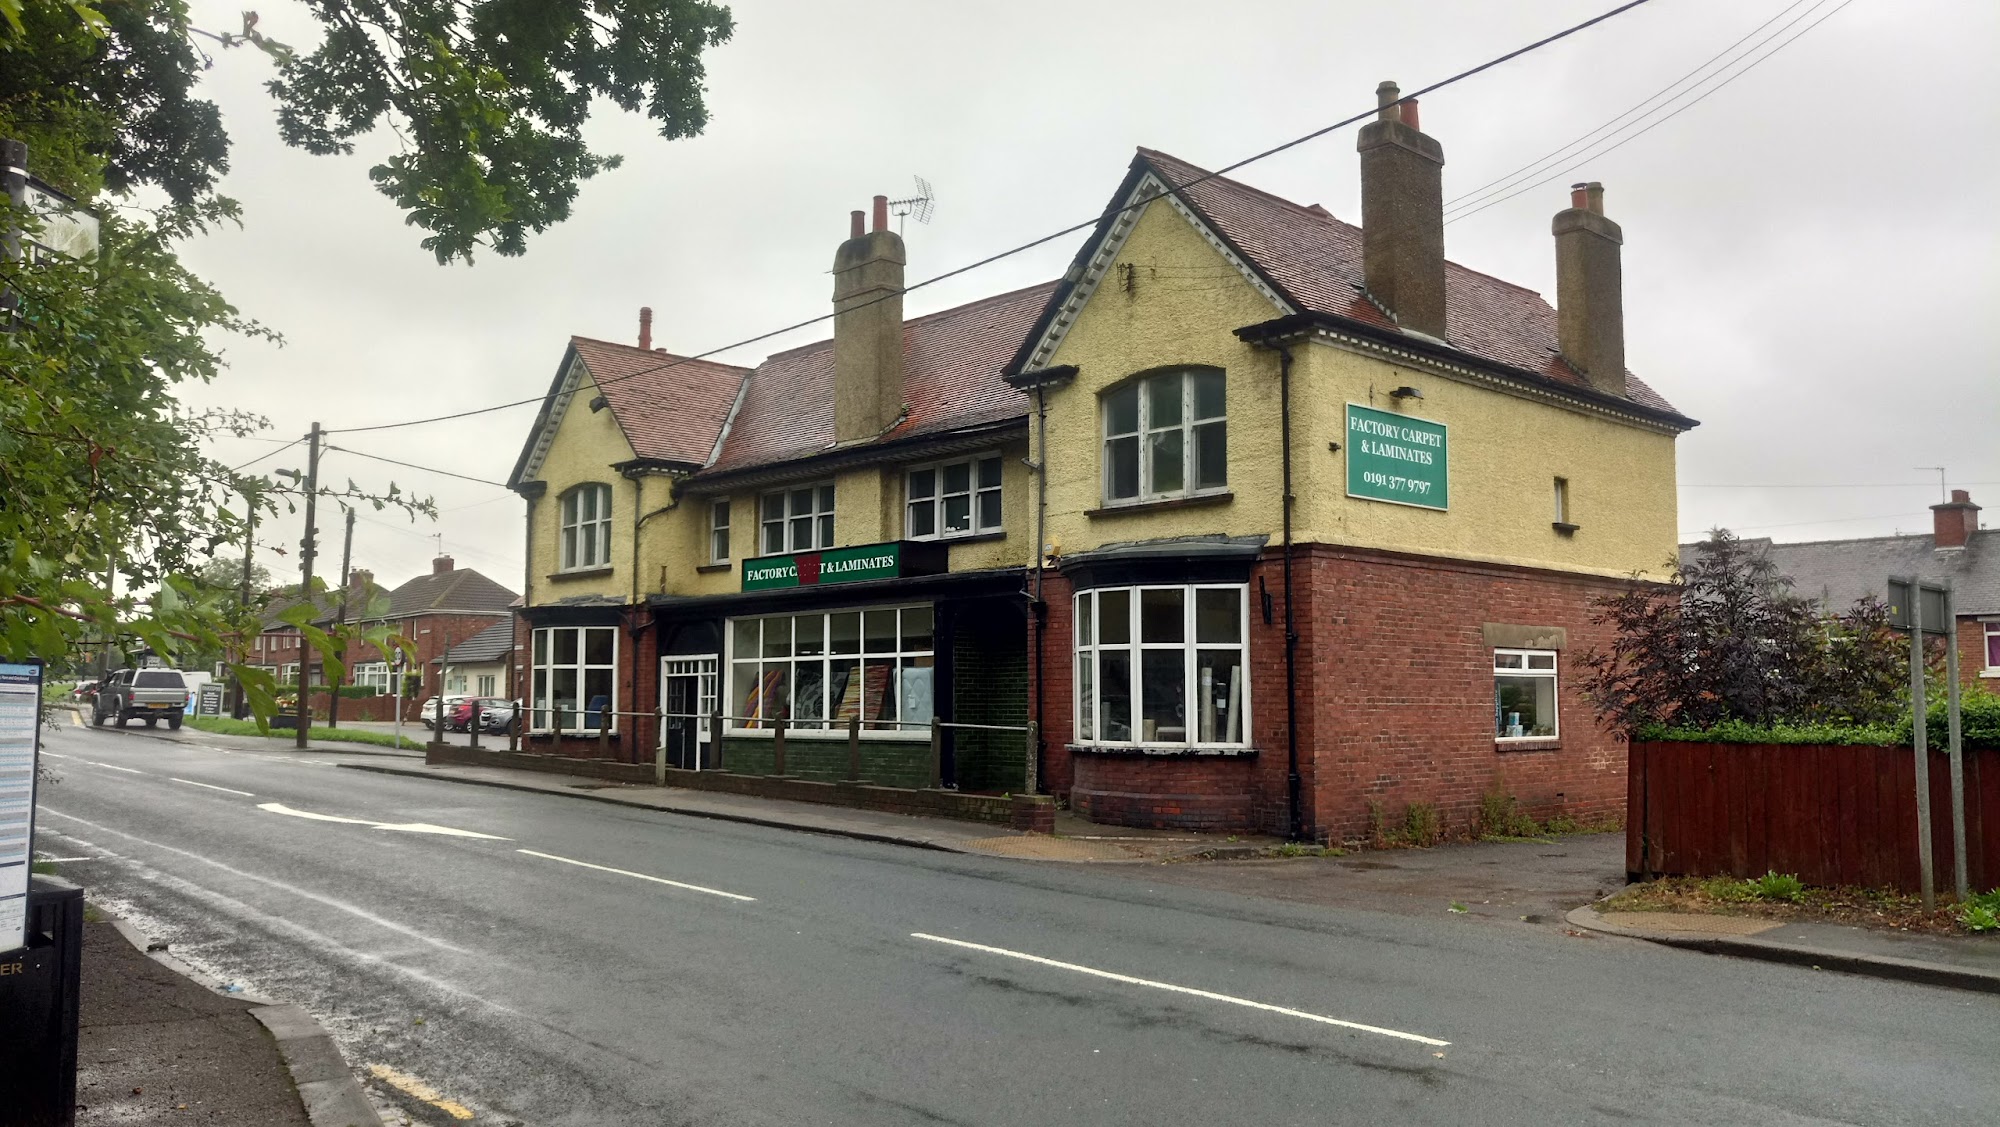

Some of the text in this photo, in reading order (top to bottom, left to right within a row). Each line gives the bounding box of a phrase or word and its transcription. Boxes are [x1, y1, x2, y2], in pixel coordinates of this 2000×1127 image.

[1350, 416, 1442, 447] FACTORY CARPET
[1361, 439, 1433, 465] & LAMINATES
[1363, 471, 1431, 495] 0191 377 9797
[747, 566, 789, 581] FACTORY
[827, 562, 835, 574] &
[835, 555, 894, 573] LAMINATES
